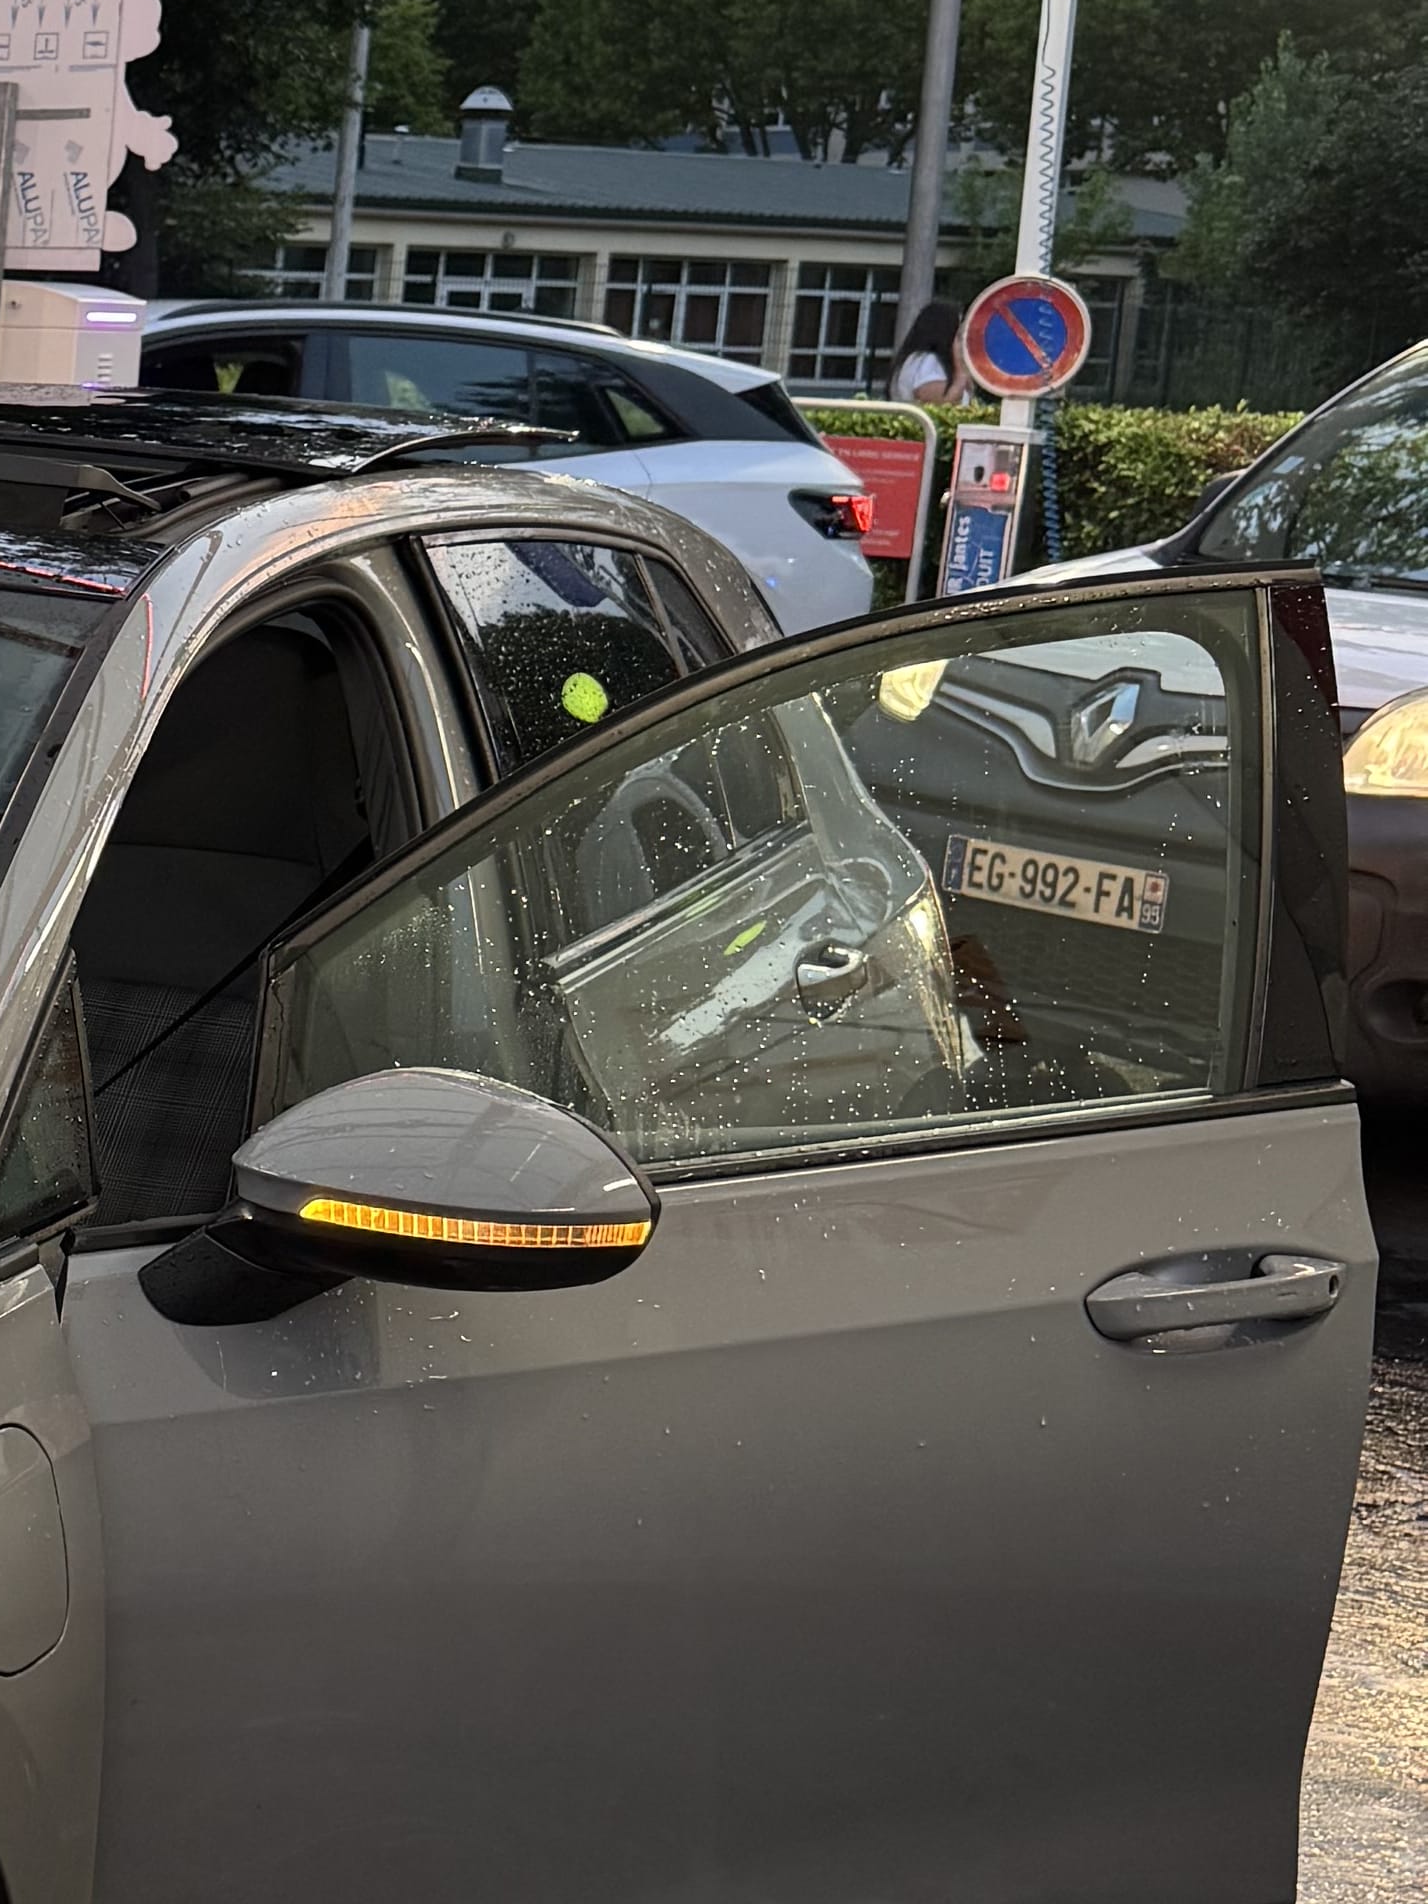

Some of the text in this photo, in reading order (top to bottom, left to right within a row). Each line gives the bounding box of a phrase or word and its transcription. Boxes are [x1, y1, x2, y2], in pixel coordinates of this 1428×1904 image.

[17, 171, 49, 245] ALUPA
[70, 171, 101, 245] ALUPA
[967, 848, 1136, 920] EG-992-FA
